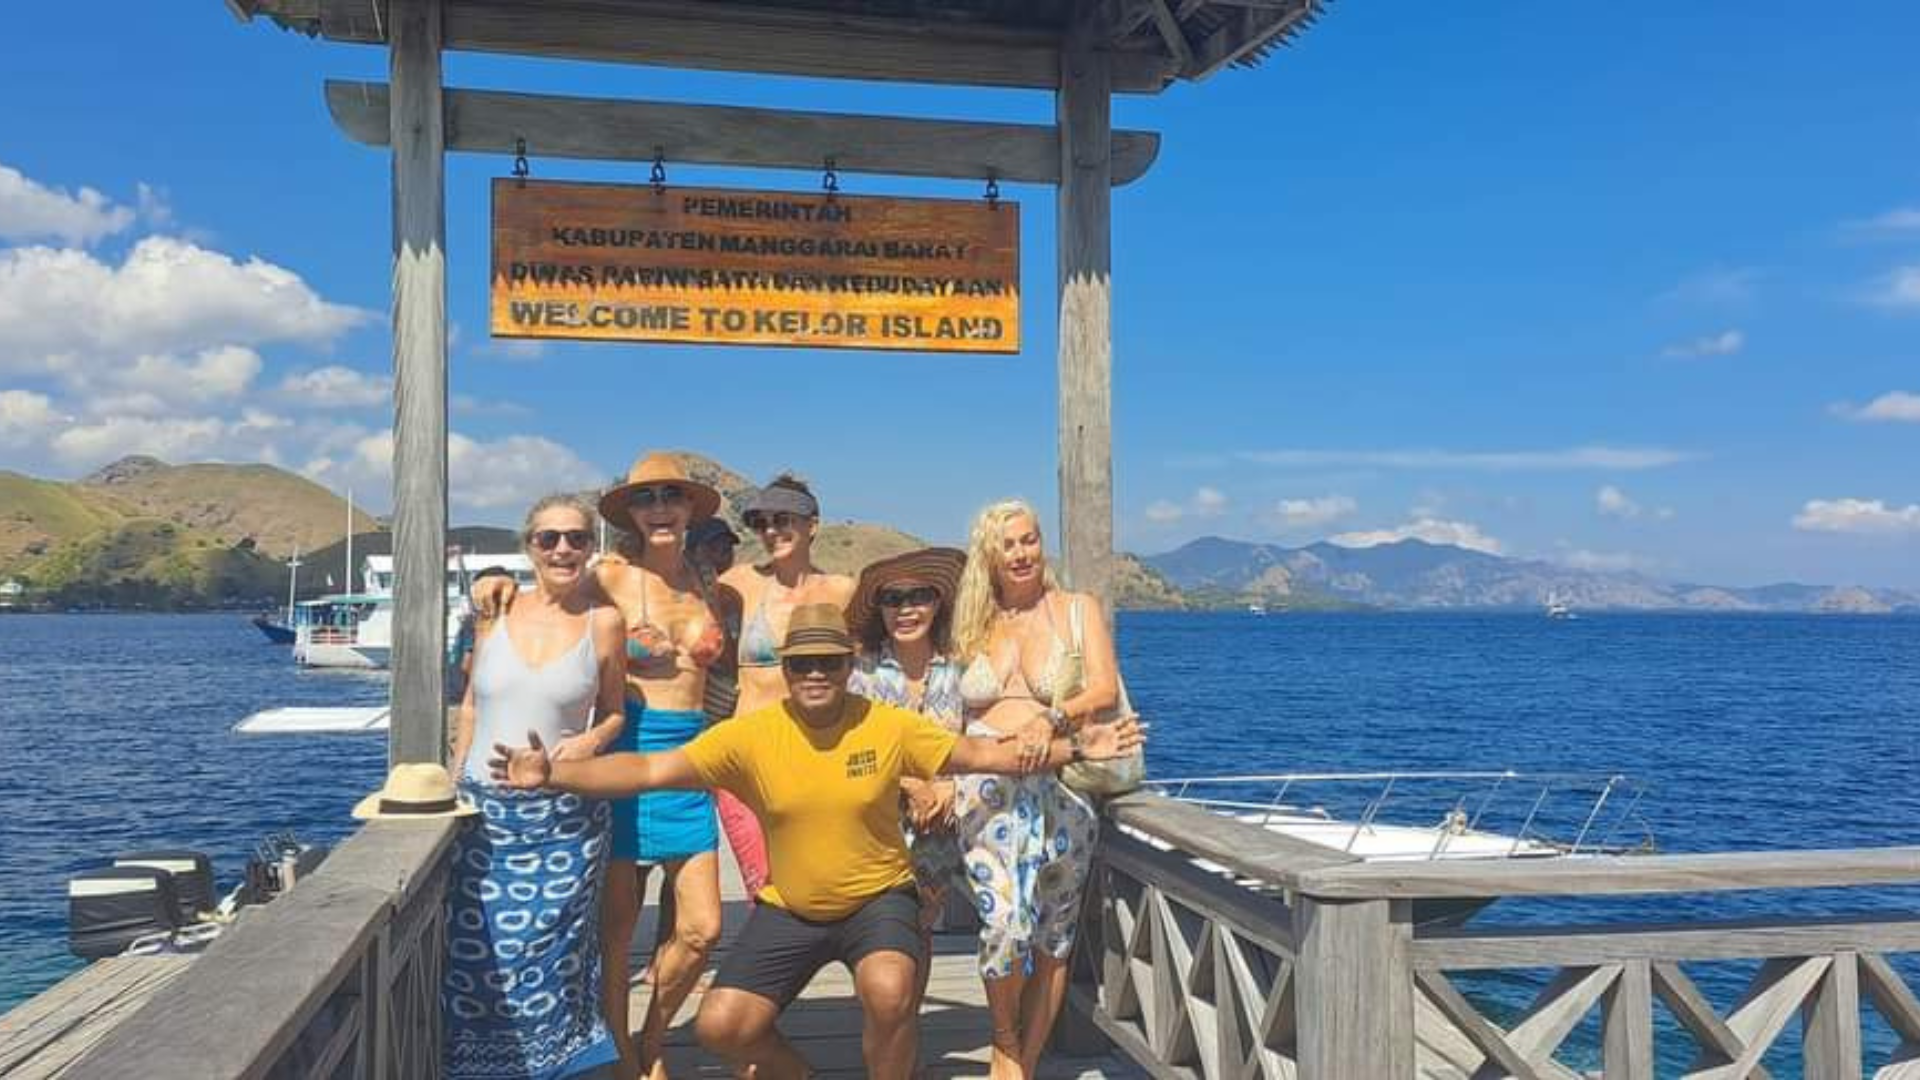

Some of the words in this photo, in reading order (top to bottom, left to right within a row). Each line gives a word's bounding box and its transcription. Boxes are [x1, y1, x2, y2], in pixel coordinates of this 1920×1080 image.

[684, 197, 852, 222] PEMERINTAH
[552, 227, 715, 251] KABUPATEN
[719, 234, 877, 258] MANGGARAI
[510, 302, 690, 330] WELCOME
[699, 307, 746, 332] TO
[754, 309, 865, 337] KELOR
[882, 313, 1004, 341] ISLAND
